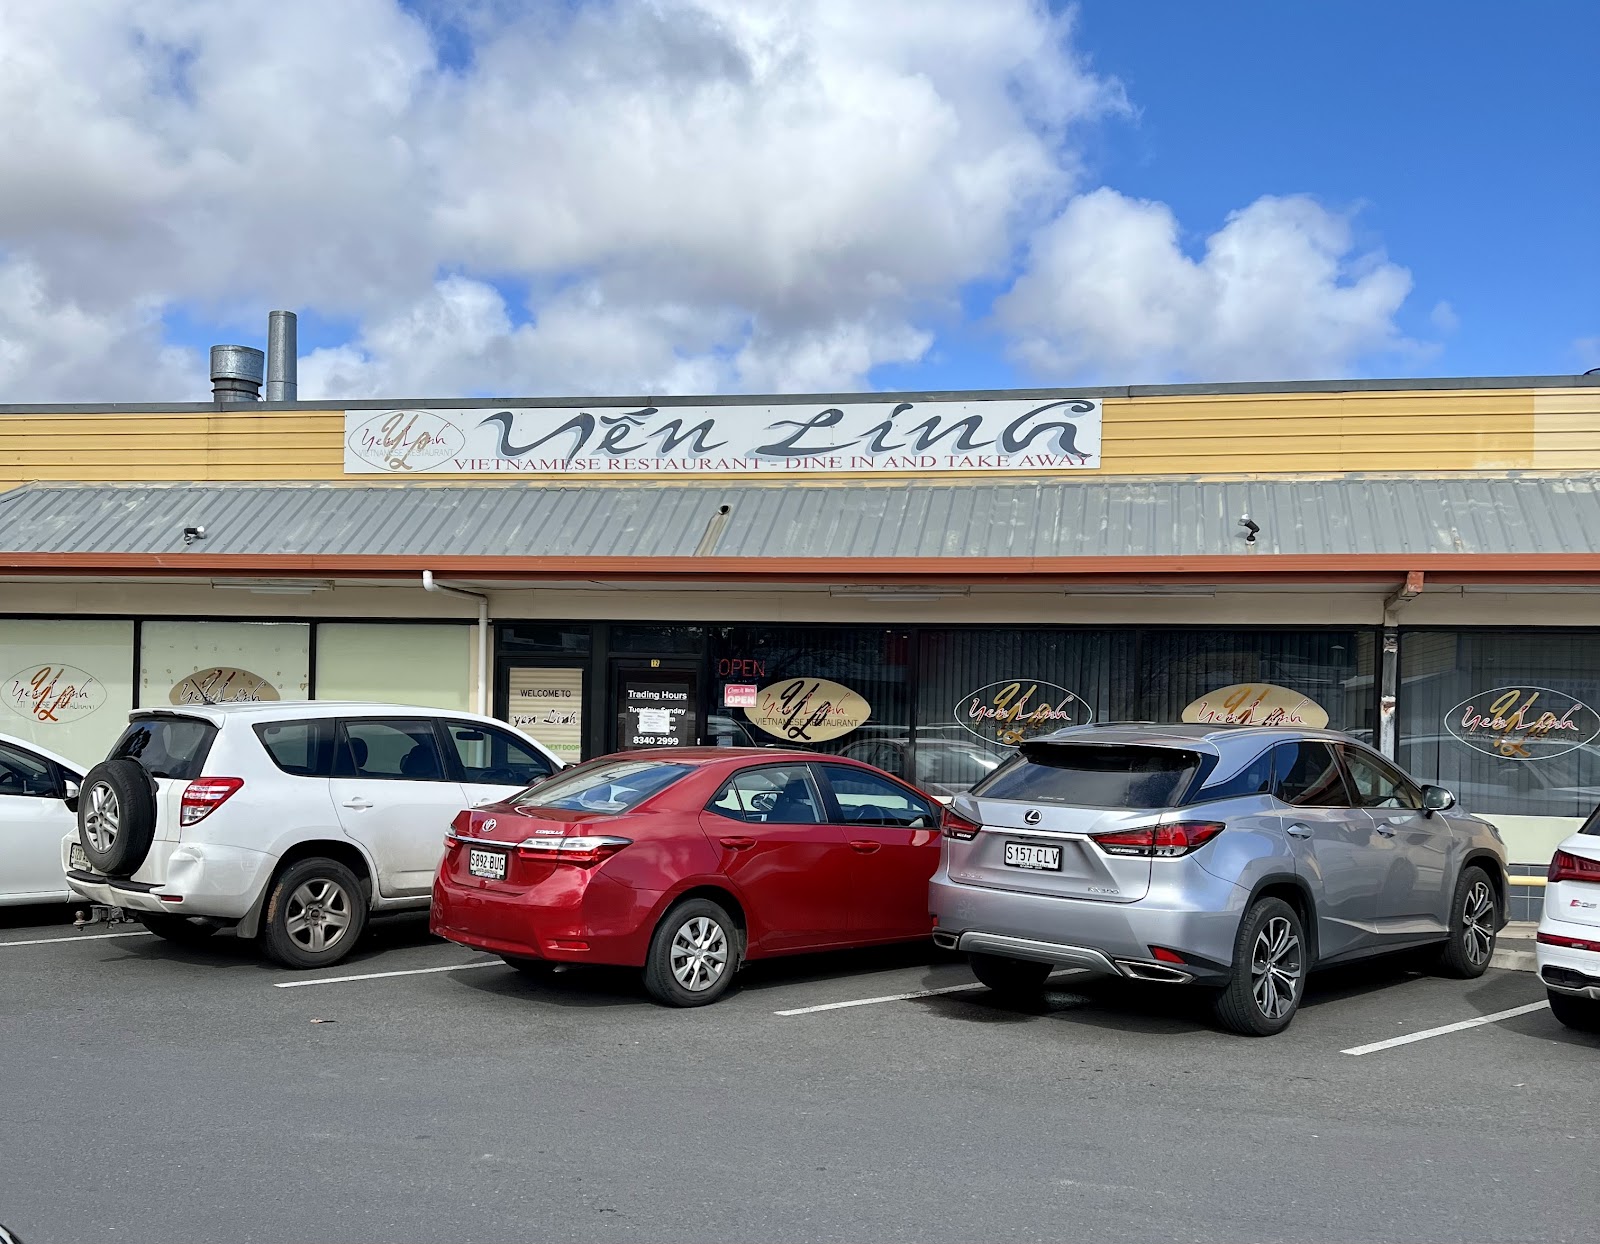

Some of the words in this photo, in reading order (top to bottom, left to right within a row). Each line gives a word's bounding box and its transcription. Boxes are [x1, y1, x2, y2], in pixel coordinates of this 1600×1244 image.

[454, 458, 601, 472] VIETNAMESE
[607, 456, 763, 471] RESTAURANT
[784, 456, 843, 470] DINE
[850, 456, 875, 469] IN
[883, 456, 937, 469] AND
[944, 455, 1010, 468] TAKE
[1018, 453, 1091, 468] AWAY
[718, 658, 765, 678] OPEN
[520, 689, 559, 698] WELCOME
[560, 690, 572, 698] TO
[627, 690, 660, 701] Trading
[661, 691, 688, 700] Hours
[727, 695, 755, 705] OPEN
[632, 736, 655, 745] 8340
[656, 737, 679, 746] 2999
